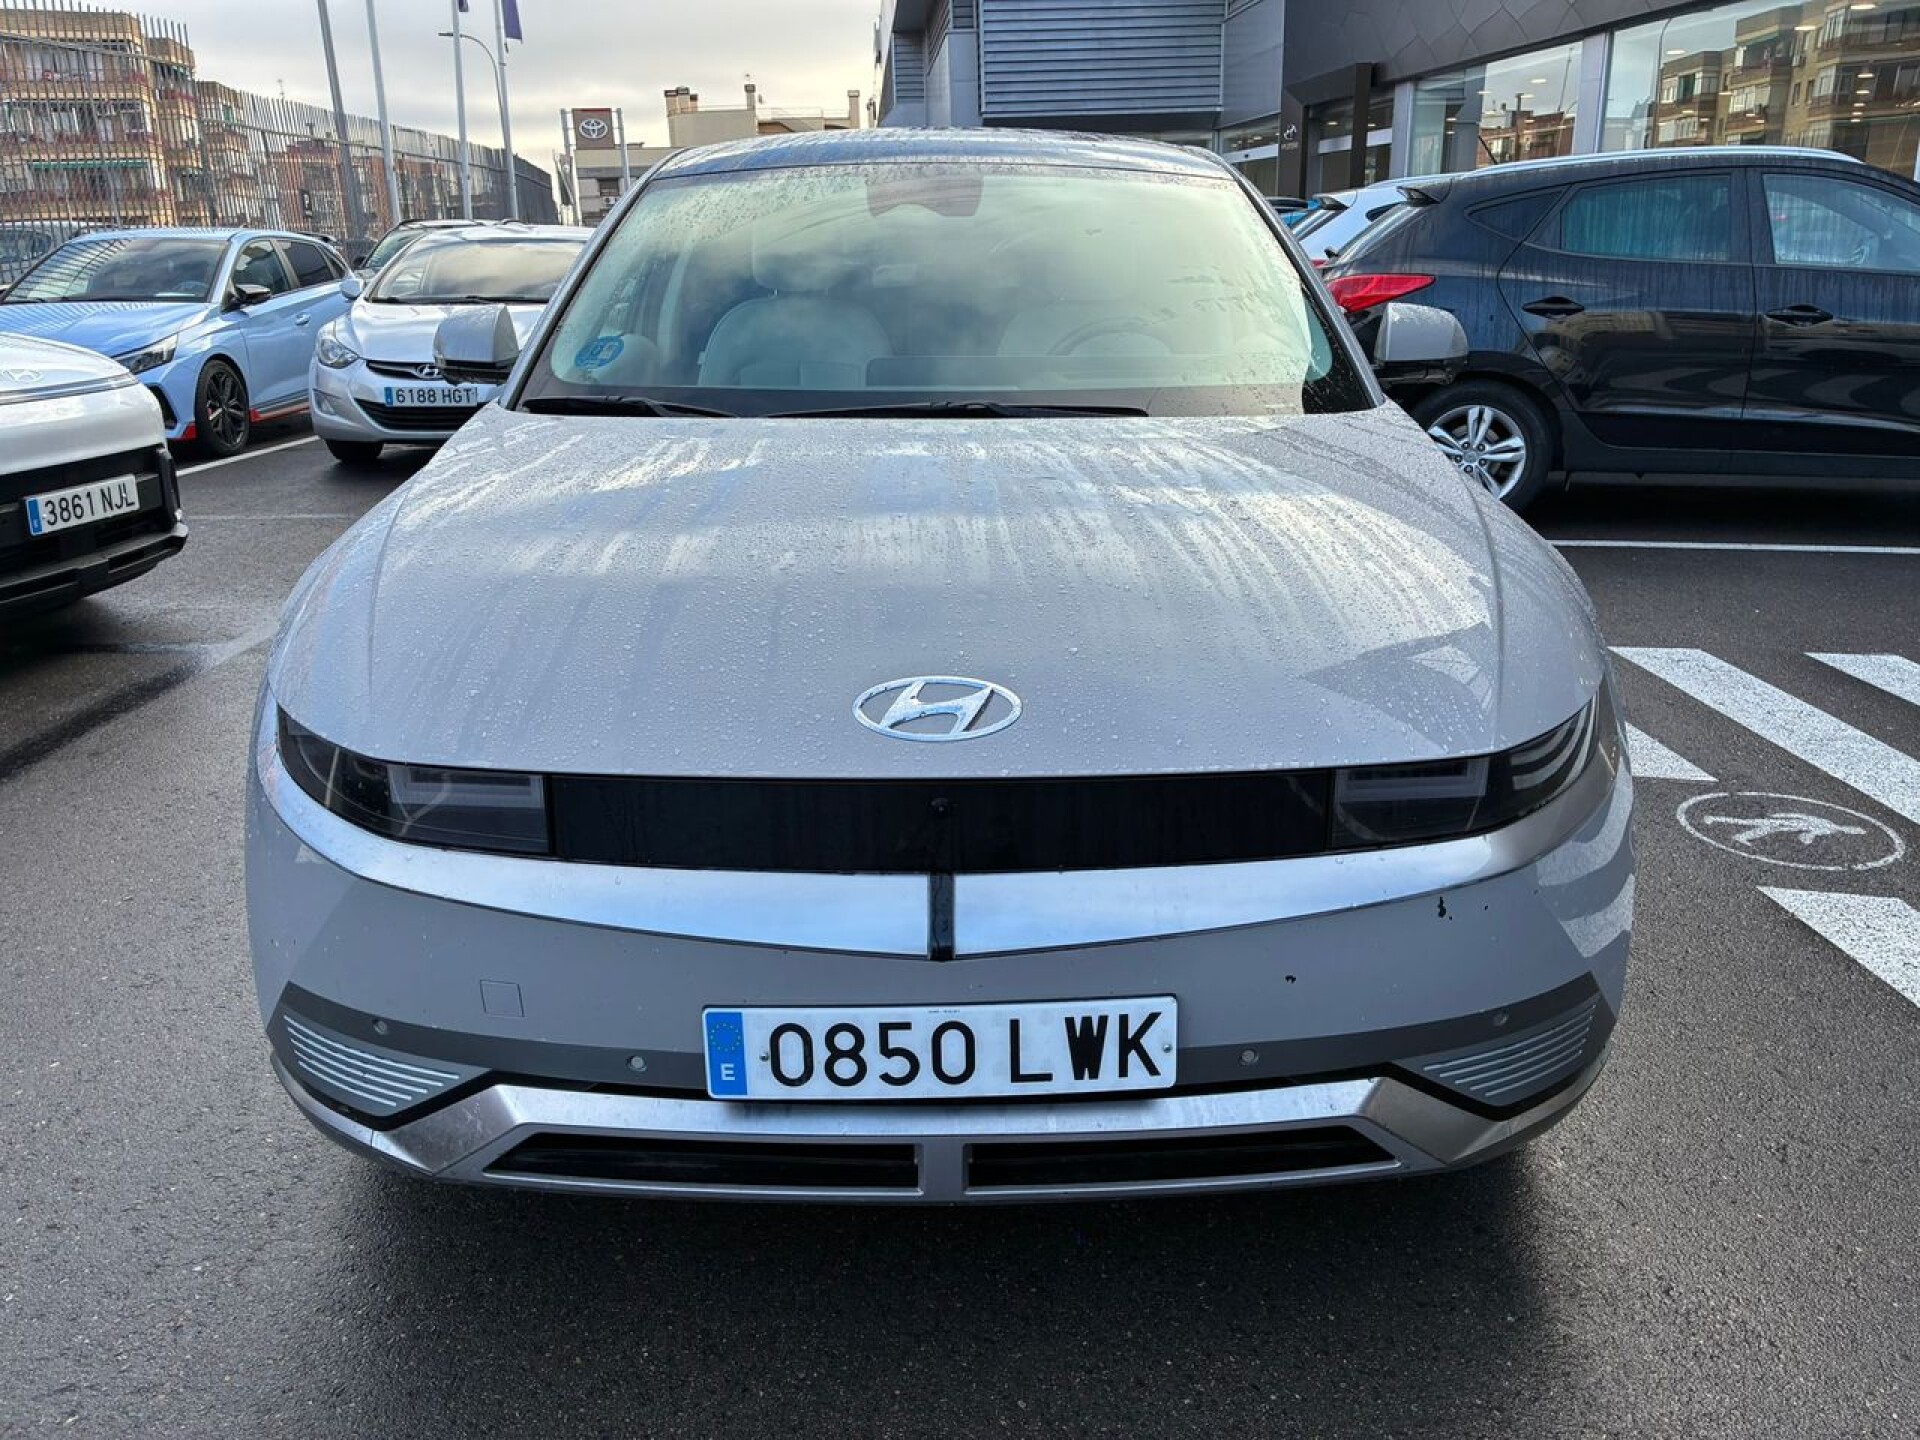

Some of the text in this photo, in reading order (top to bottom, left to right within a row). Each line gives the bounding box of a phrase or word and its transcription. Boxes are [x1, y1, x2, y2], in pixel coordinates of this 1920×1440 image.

[395, 388, 472, 404] 6188 HGT
[45, 482, 135, 526] 3861 NJL
[769, 1012, 1163, 1087] 0850 LWK
[720, 1063, 736, 1081] E
